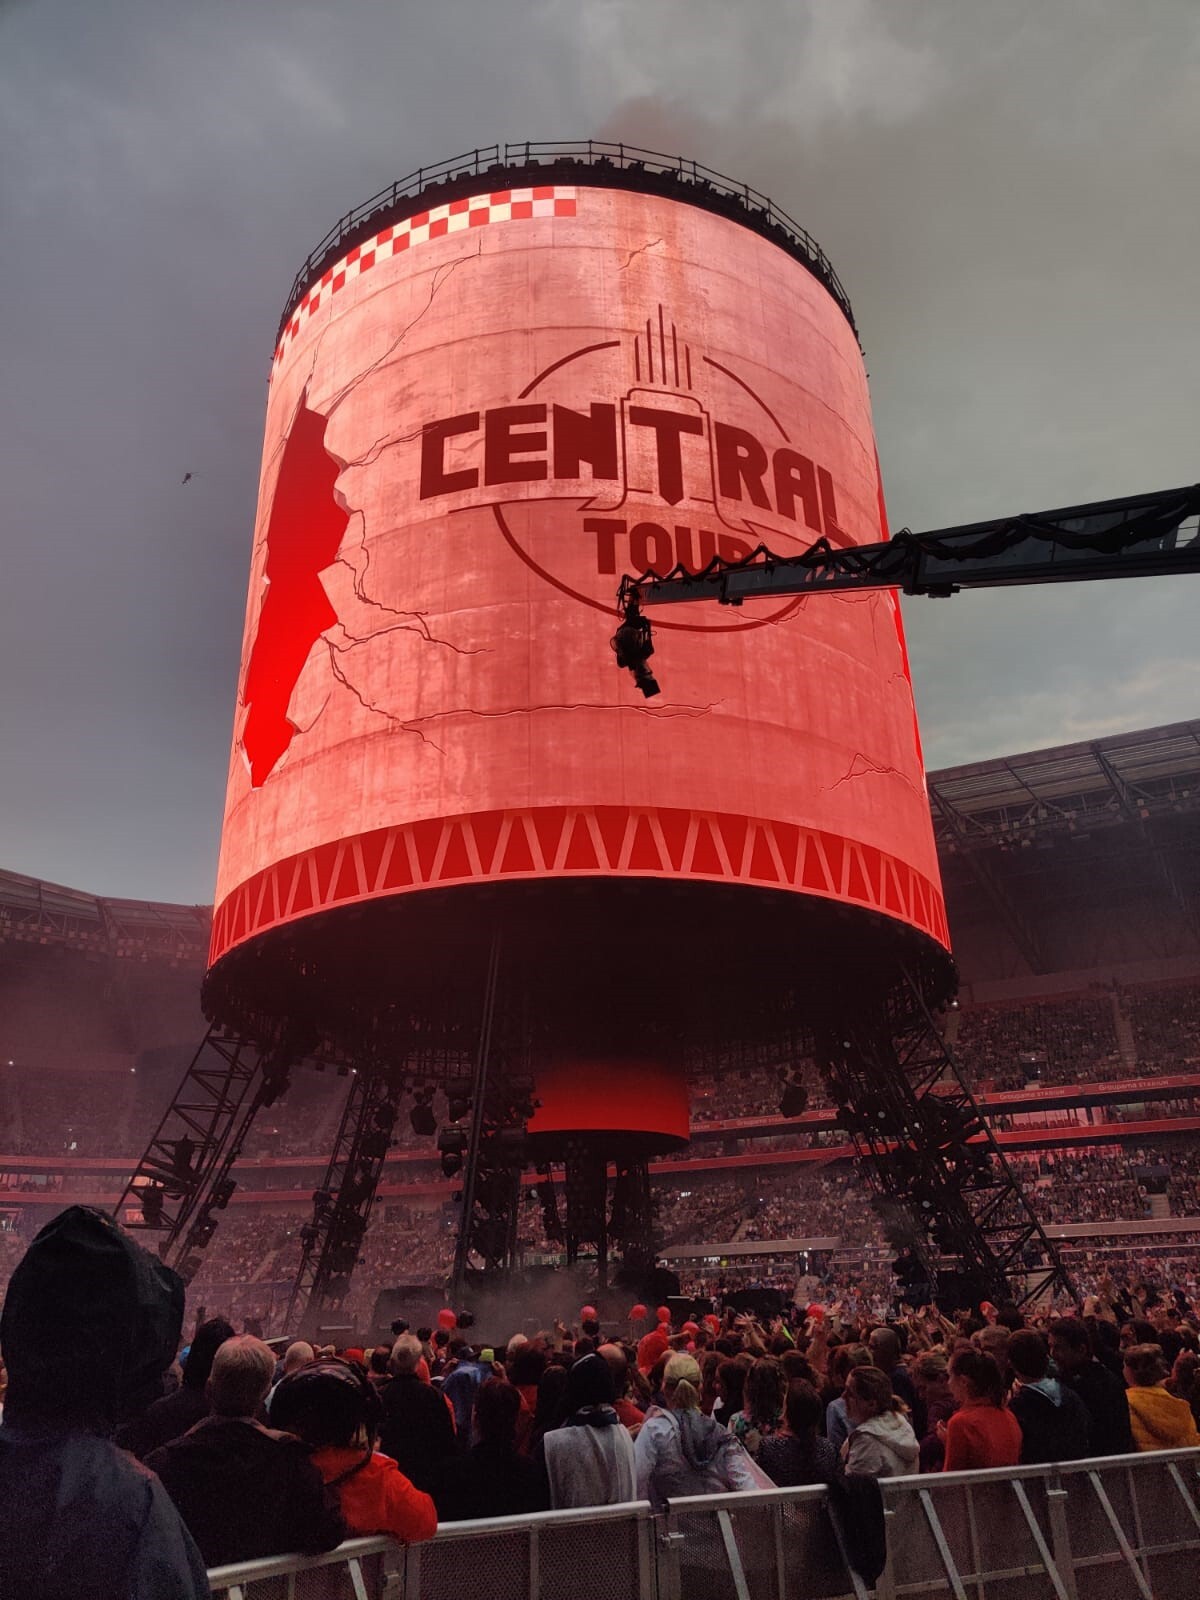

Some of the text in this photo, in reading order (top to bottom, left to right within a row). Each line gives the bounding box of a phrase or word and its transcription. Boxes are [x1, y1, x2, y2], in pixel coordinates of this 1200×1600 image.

[420, 403, 858, 549] CENTRAL
[1099, 1080, 1169, 1091] Groupama STADIUM
